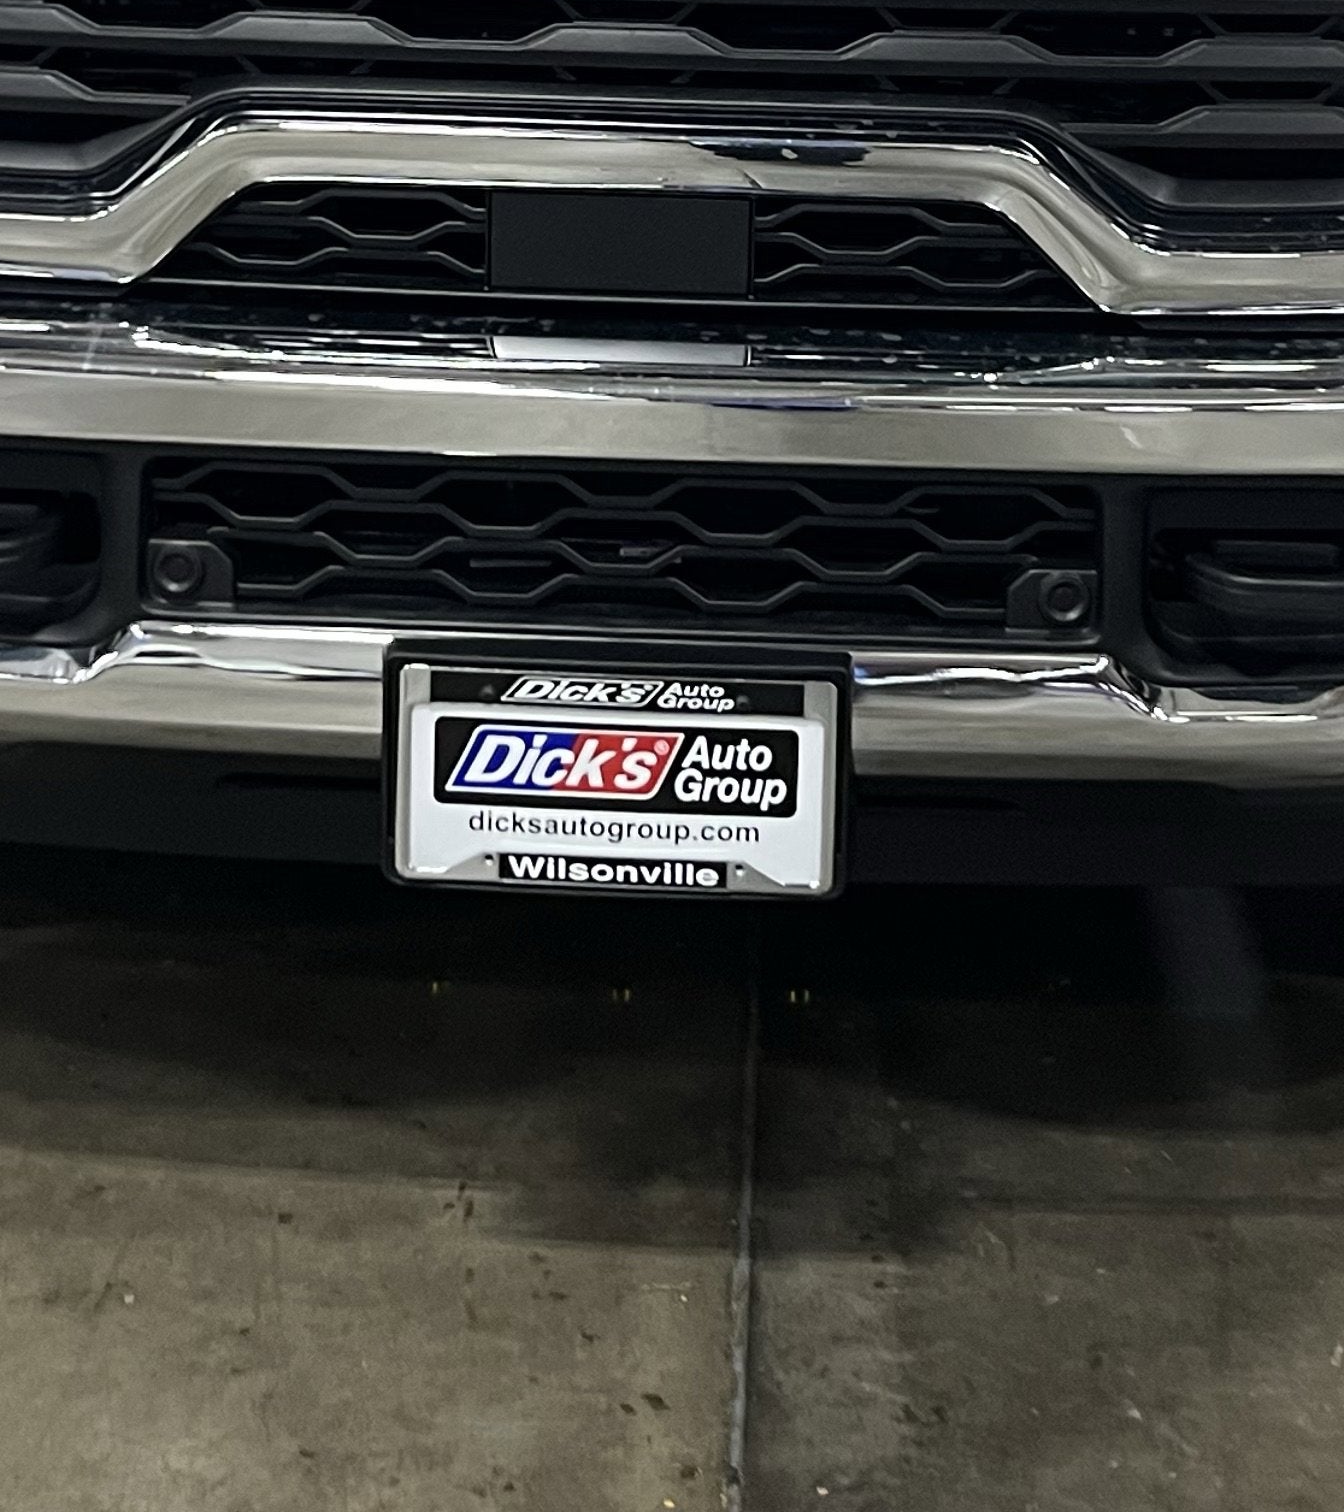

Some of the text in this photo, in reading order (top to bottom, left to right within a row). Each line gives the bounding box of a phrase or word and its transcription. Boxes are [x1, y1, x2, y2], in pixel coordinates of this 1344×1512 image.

[657, 694, 735, 713] Group
[664, 682, 725, 698] Auto
[463, 734, 773, 790] Dick's Auto
[674, 768, 788, 811] Group
[468, 810, 760, 845] dicksautogroup.com
[507, 855, 720, 887] Wilsonville
